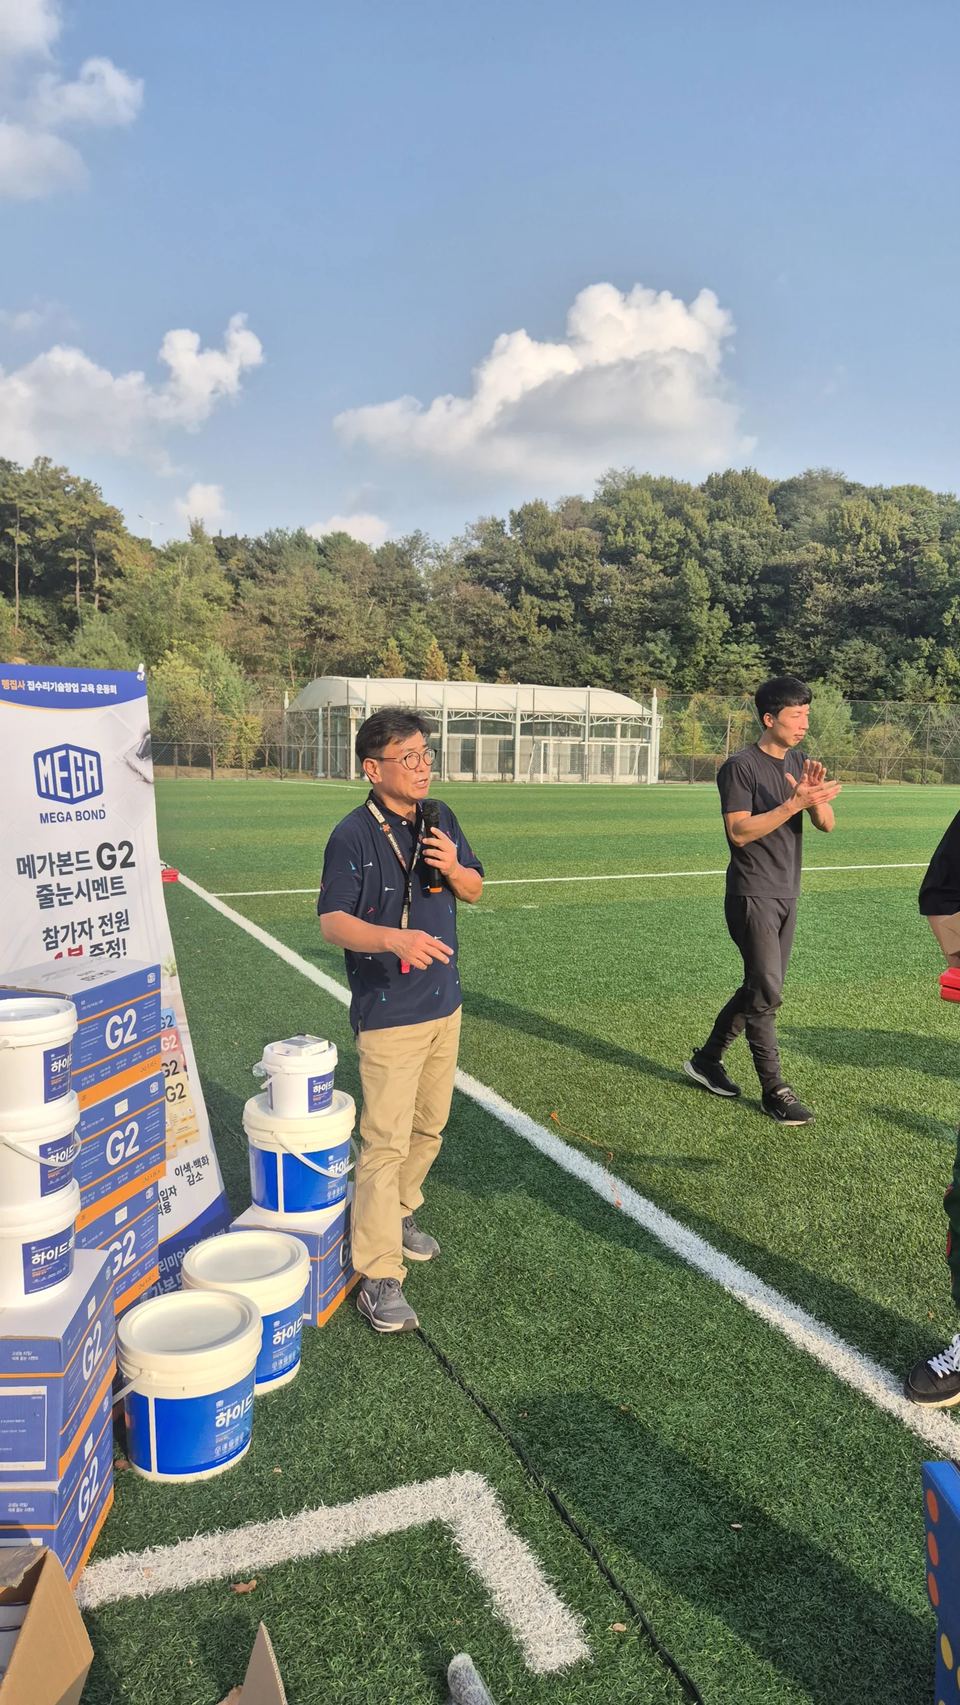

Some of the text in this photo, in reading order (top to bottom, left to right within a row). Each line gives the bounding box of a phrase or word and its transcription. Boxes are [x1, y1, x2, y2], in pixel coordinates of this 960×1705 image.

[37, 749, 100, 800] MEGA
[39, 808, 106, 825] MEGA BOND
[16, 839, 136, 880] 메가본드 G2
[35, 874, 127, 910] 줄눈시멘트
[42, 908, 131, 951] 참가자 전원
[105, 1008, 138, 1050] G2
[161, 1034, 179, 1052] G2
[165, 1082, 187, 1103] G2
[105, 1121, 140, 1166] G2
[158, 1185, 177, 1203] 입자
[186, 1171, 204, 1186] 감소
[108, 1229, 137, 1277] G2
[82, 1320, 103, 1382] G2
[78, 1455, 100, 1524] G2
